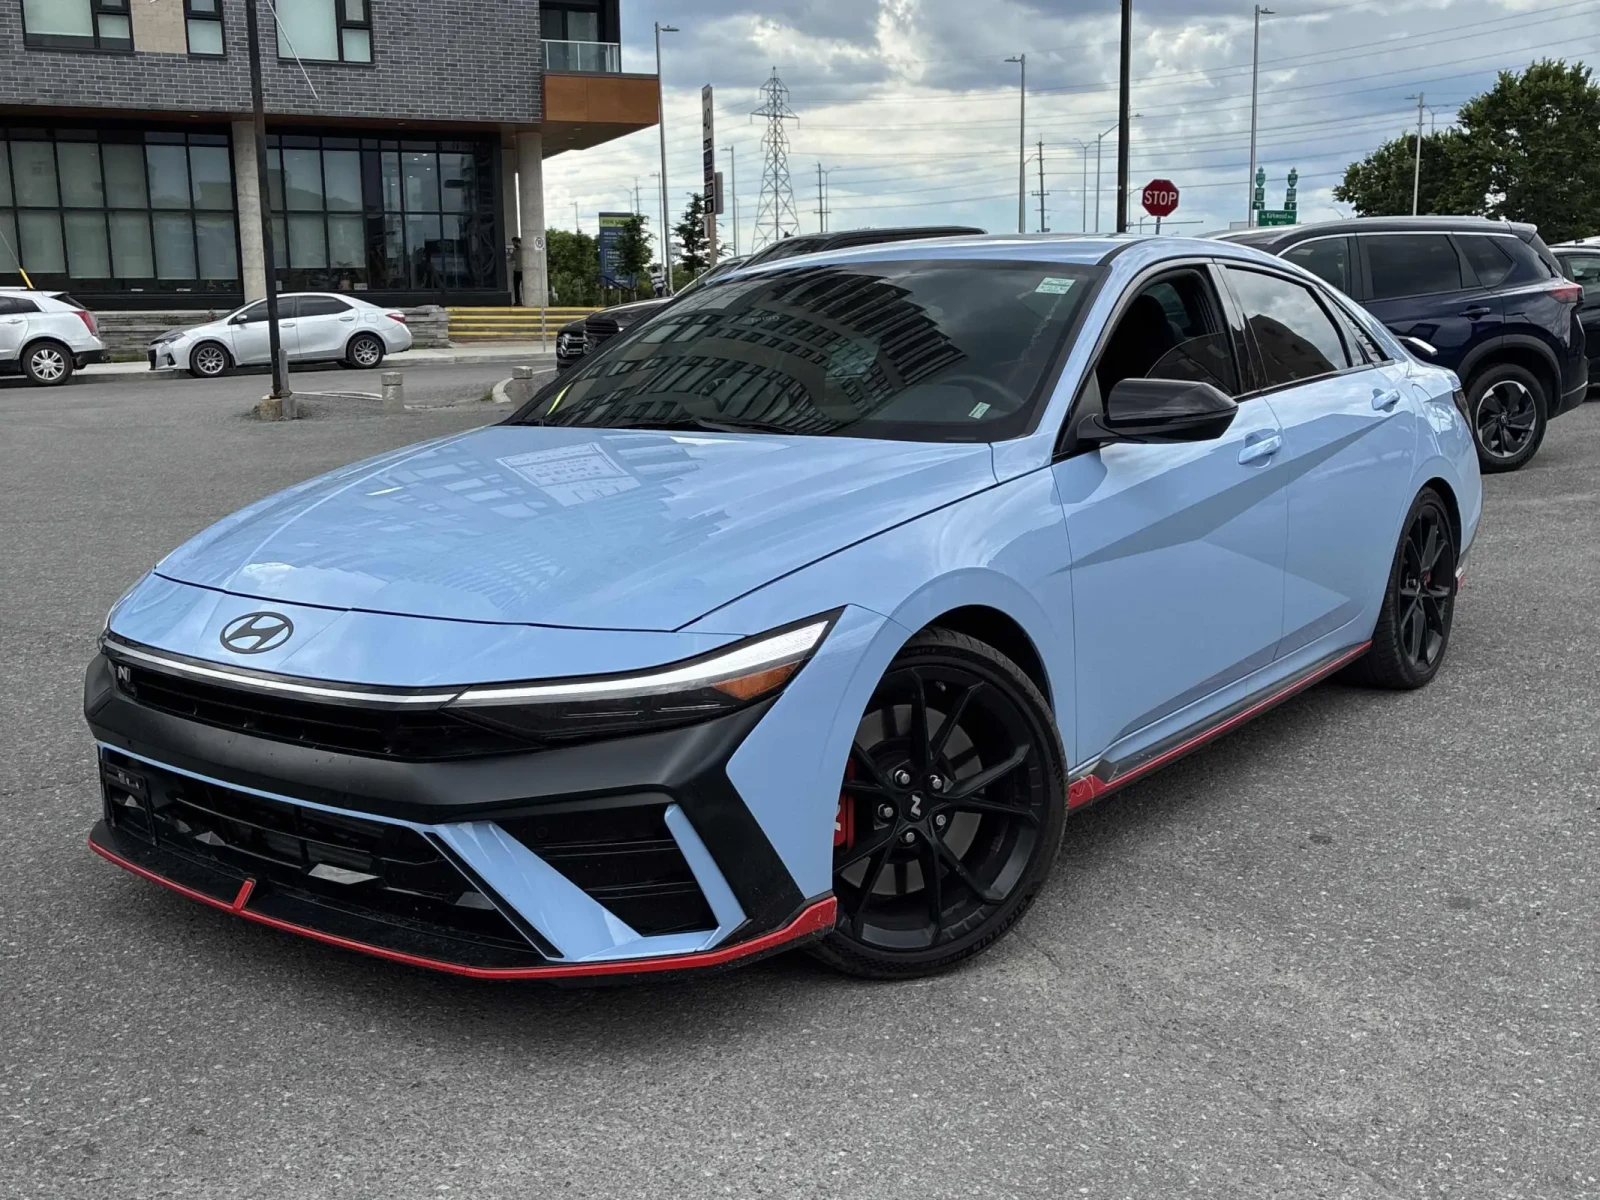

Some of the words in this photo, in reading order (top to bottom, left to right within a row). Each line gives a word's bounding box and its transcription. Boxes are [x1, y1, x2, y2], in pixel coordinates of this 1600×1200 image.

[1144, 190, 1177, 206] STOP
[1266, 212, 1288, 220] Kirkwood
[117, 665, 130, 682] N
